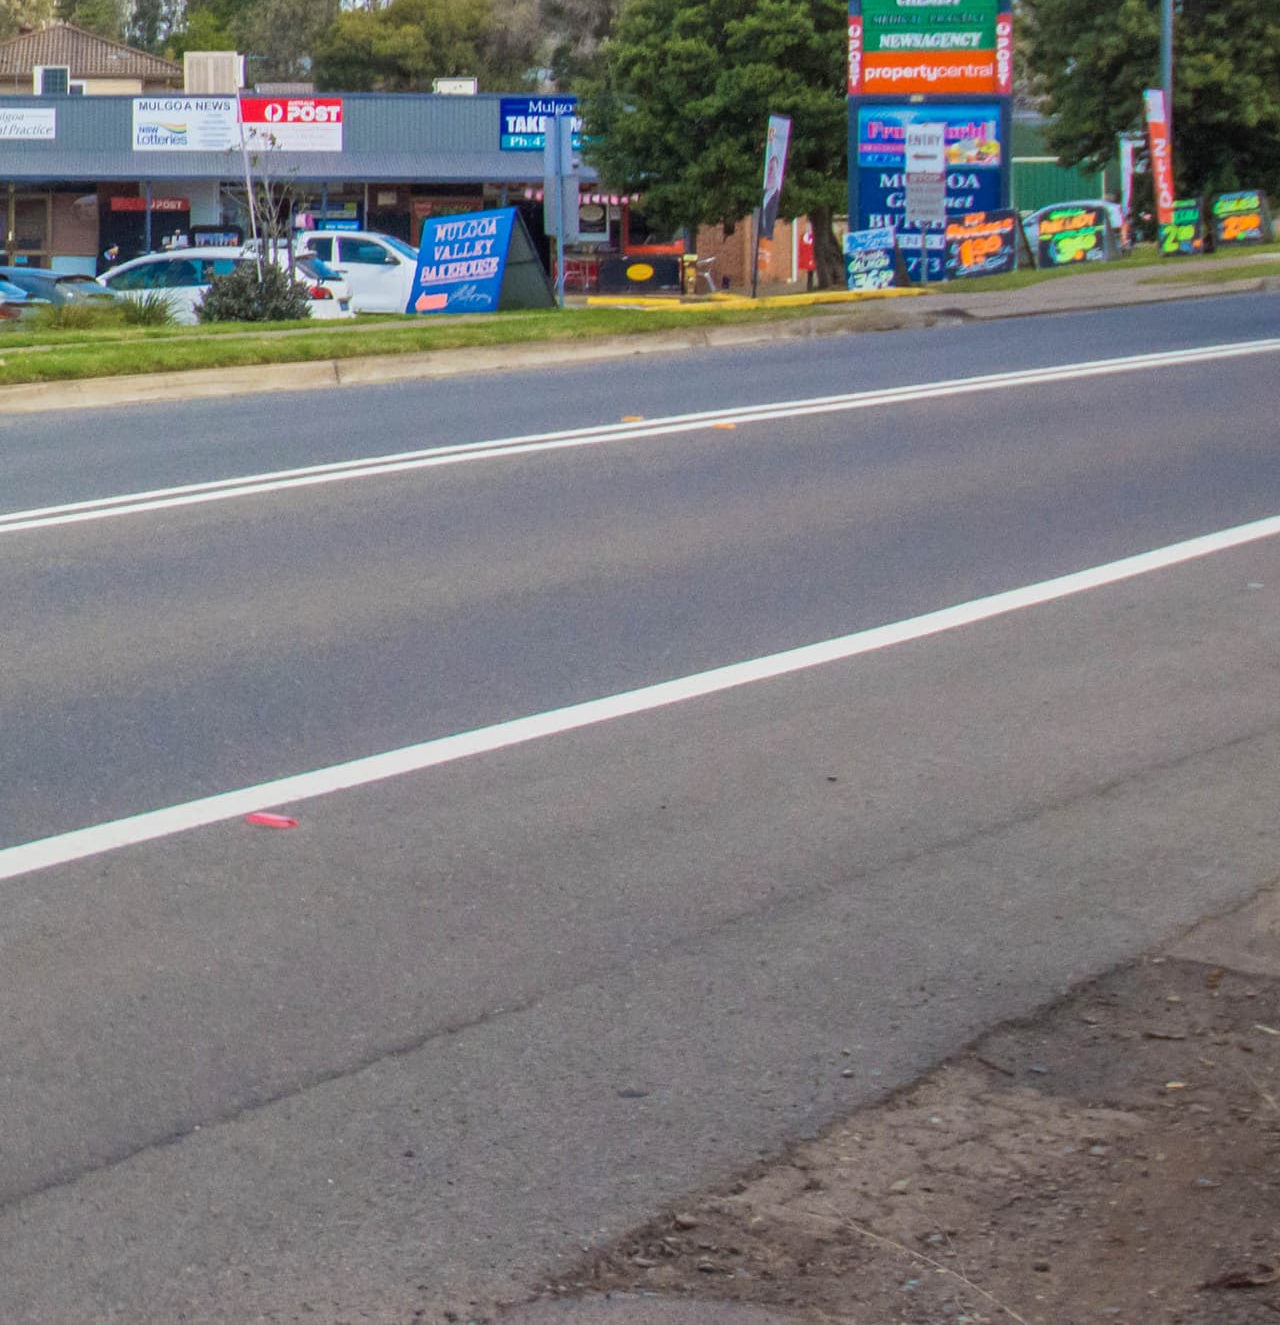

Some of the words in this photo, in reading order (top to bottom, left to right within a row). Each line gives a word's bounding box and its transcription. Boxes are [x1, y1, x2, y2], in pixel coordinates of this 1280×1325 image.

[879, 32, 983, 50] NEWSAGENCY
[864, 63, 993, 82] propertycentral
[139, 101, 192, 111] MULGOA
[195, 101, 231, 111] NEWS
[287, 106, 341, 122] POST
[528, 100, 573, 114] Mulgo
[8, 124, 53, 135] Practice
[137, 132, 188, 146] Lotteries
[156, 199, 183, 210] POST
[435, 218, 497, 242] MULGOA
[434, 239, 494, 261] VALLEY
[421, 257, 499, 282] BAKEHOUSE
